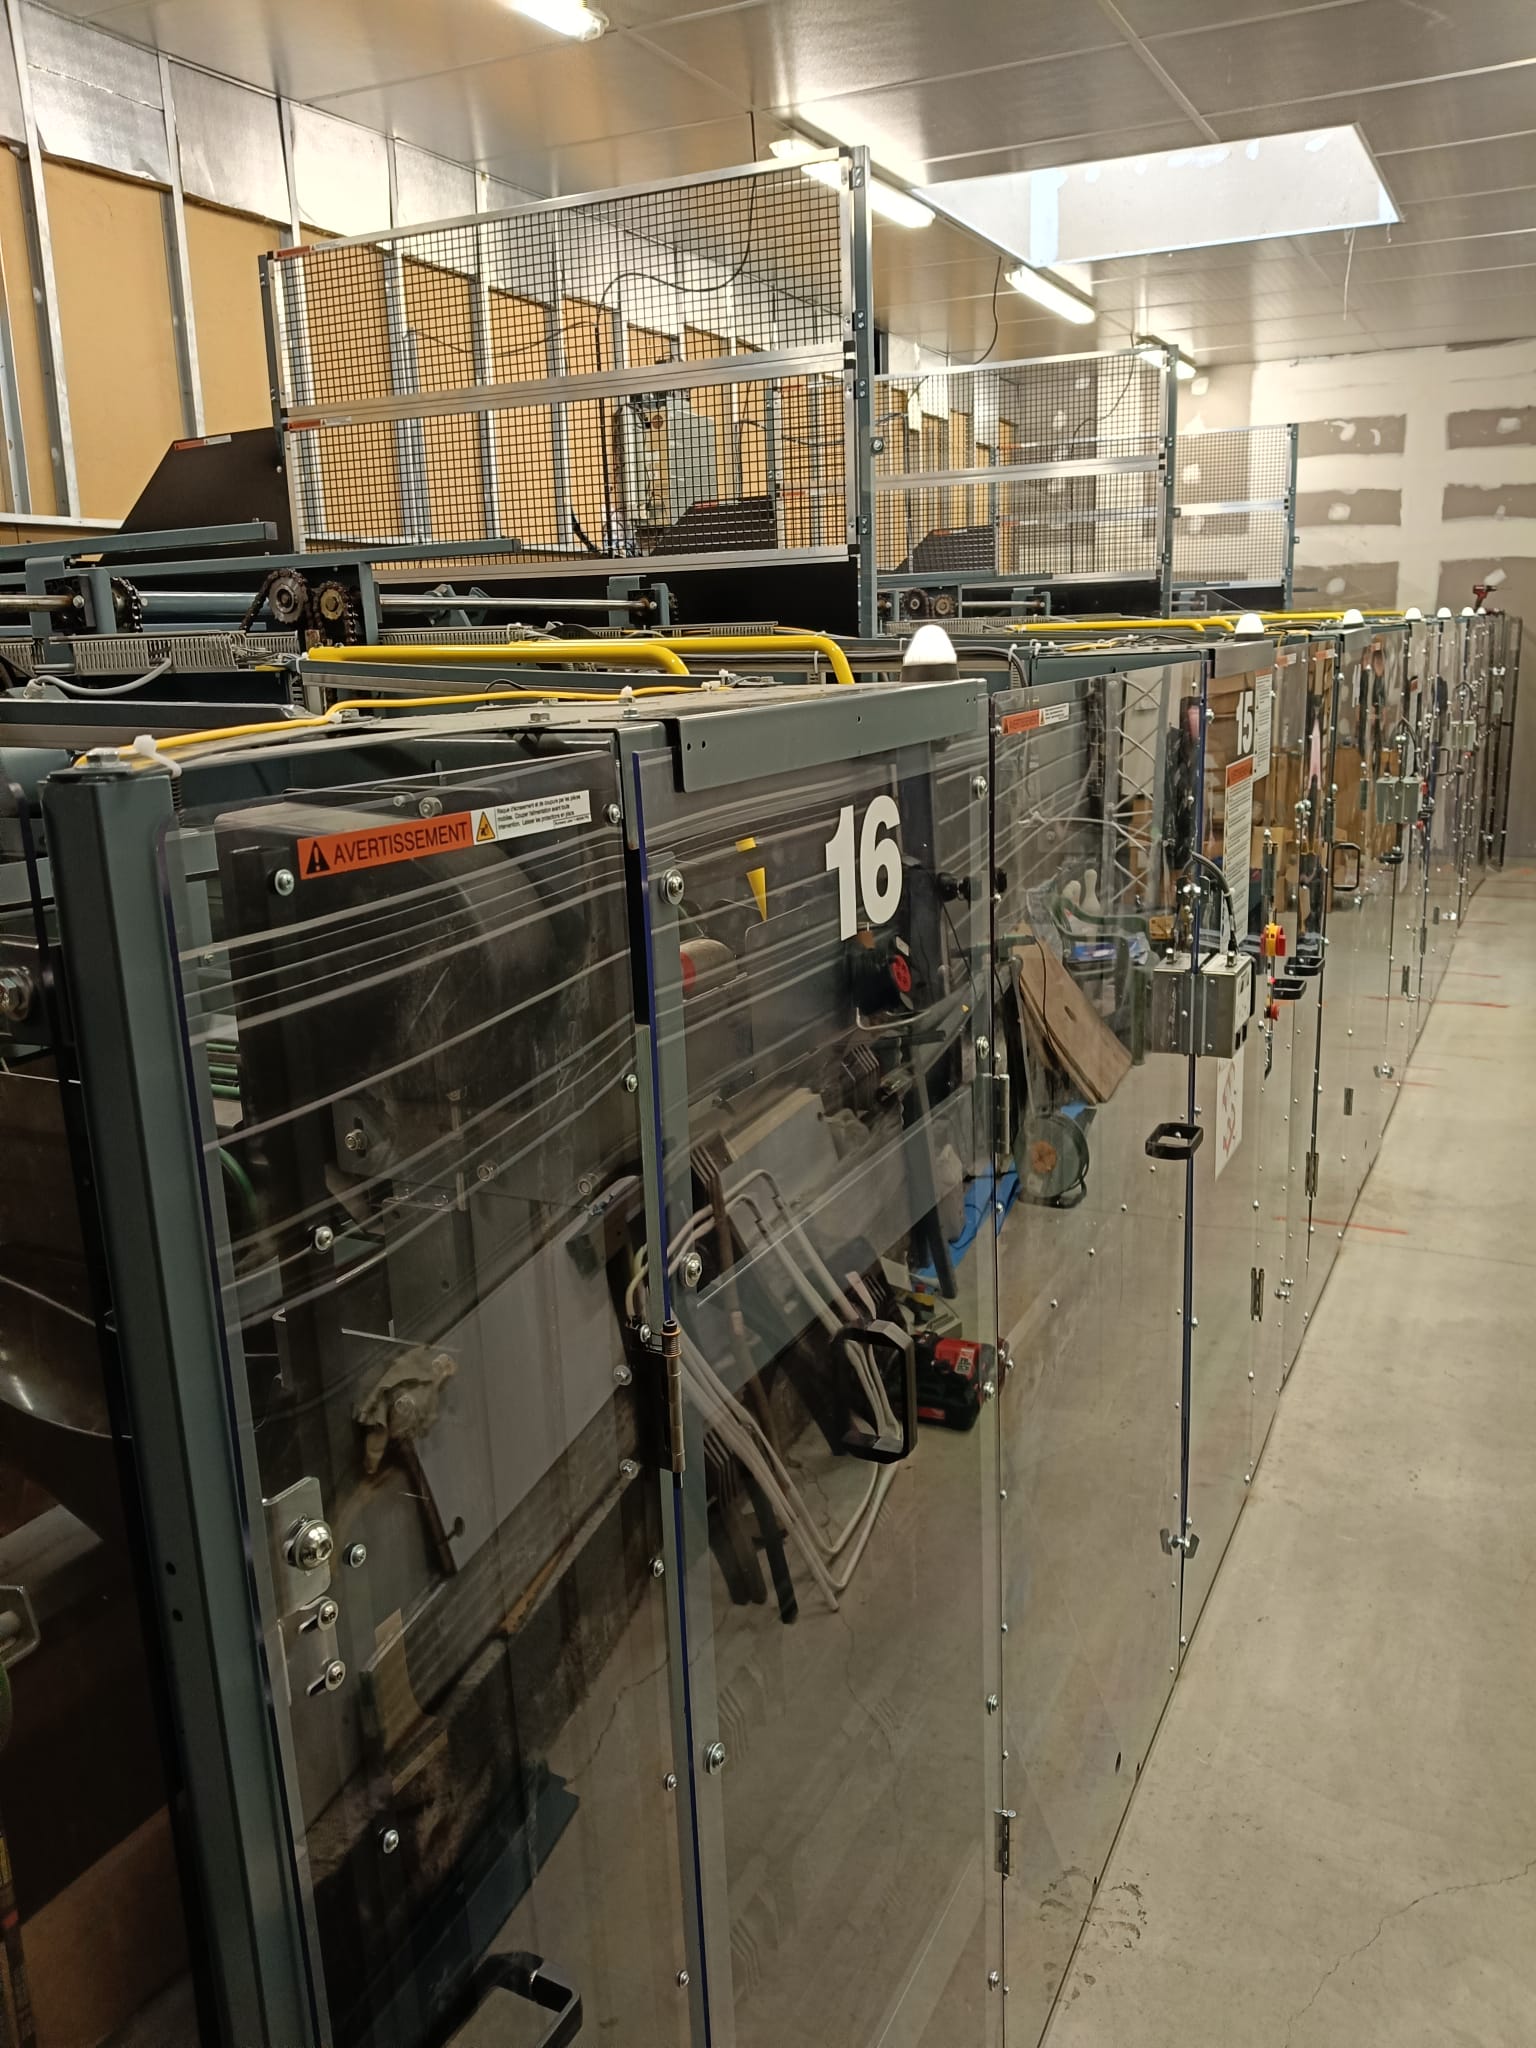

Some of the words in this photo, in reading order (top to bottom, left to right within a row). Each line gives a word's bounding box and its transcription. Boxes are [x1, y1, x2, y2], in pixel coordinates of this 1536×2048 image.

[1236, 691, 1253, 755] 15
[334, 822, 467, 865] AVERTISSEMENT
[825, 795, 902, 941] 16
